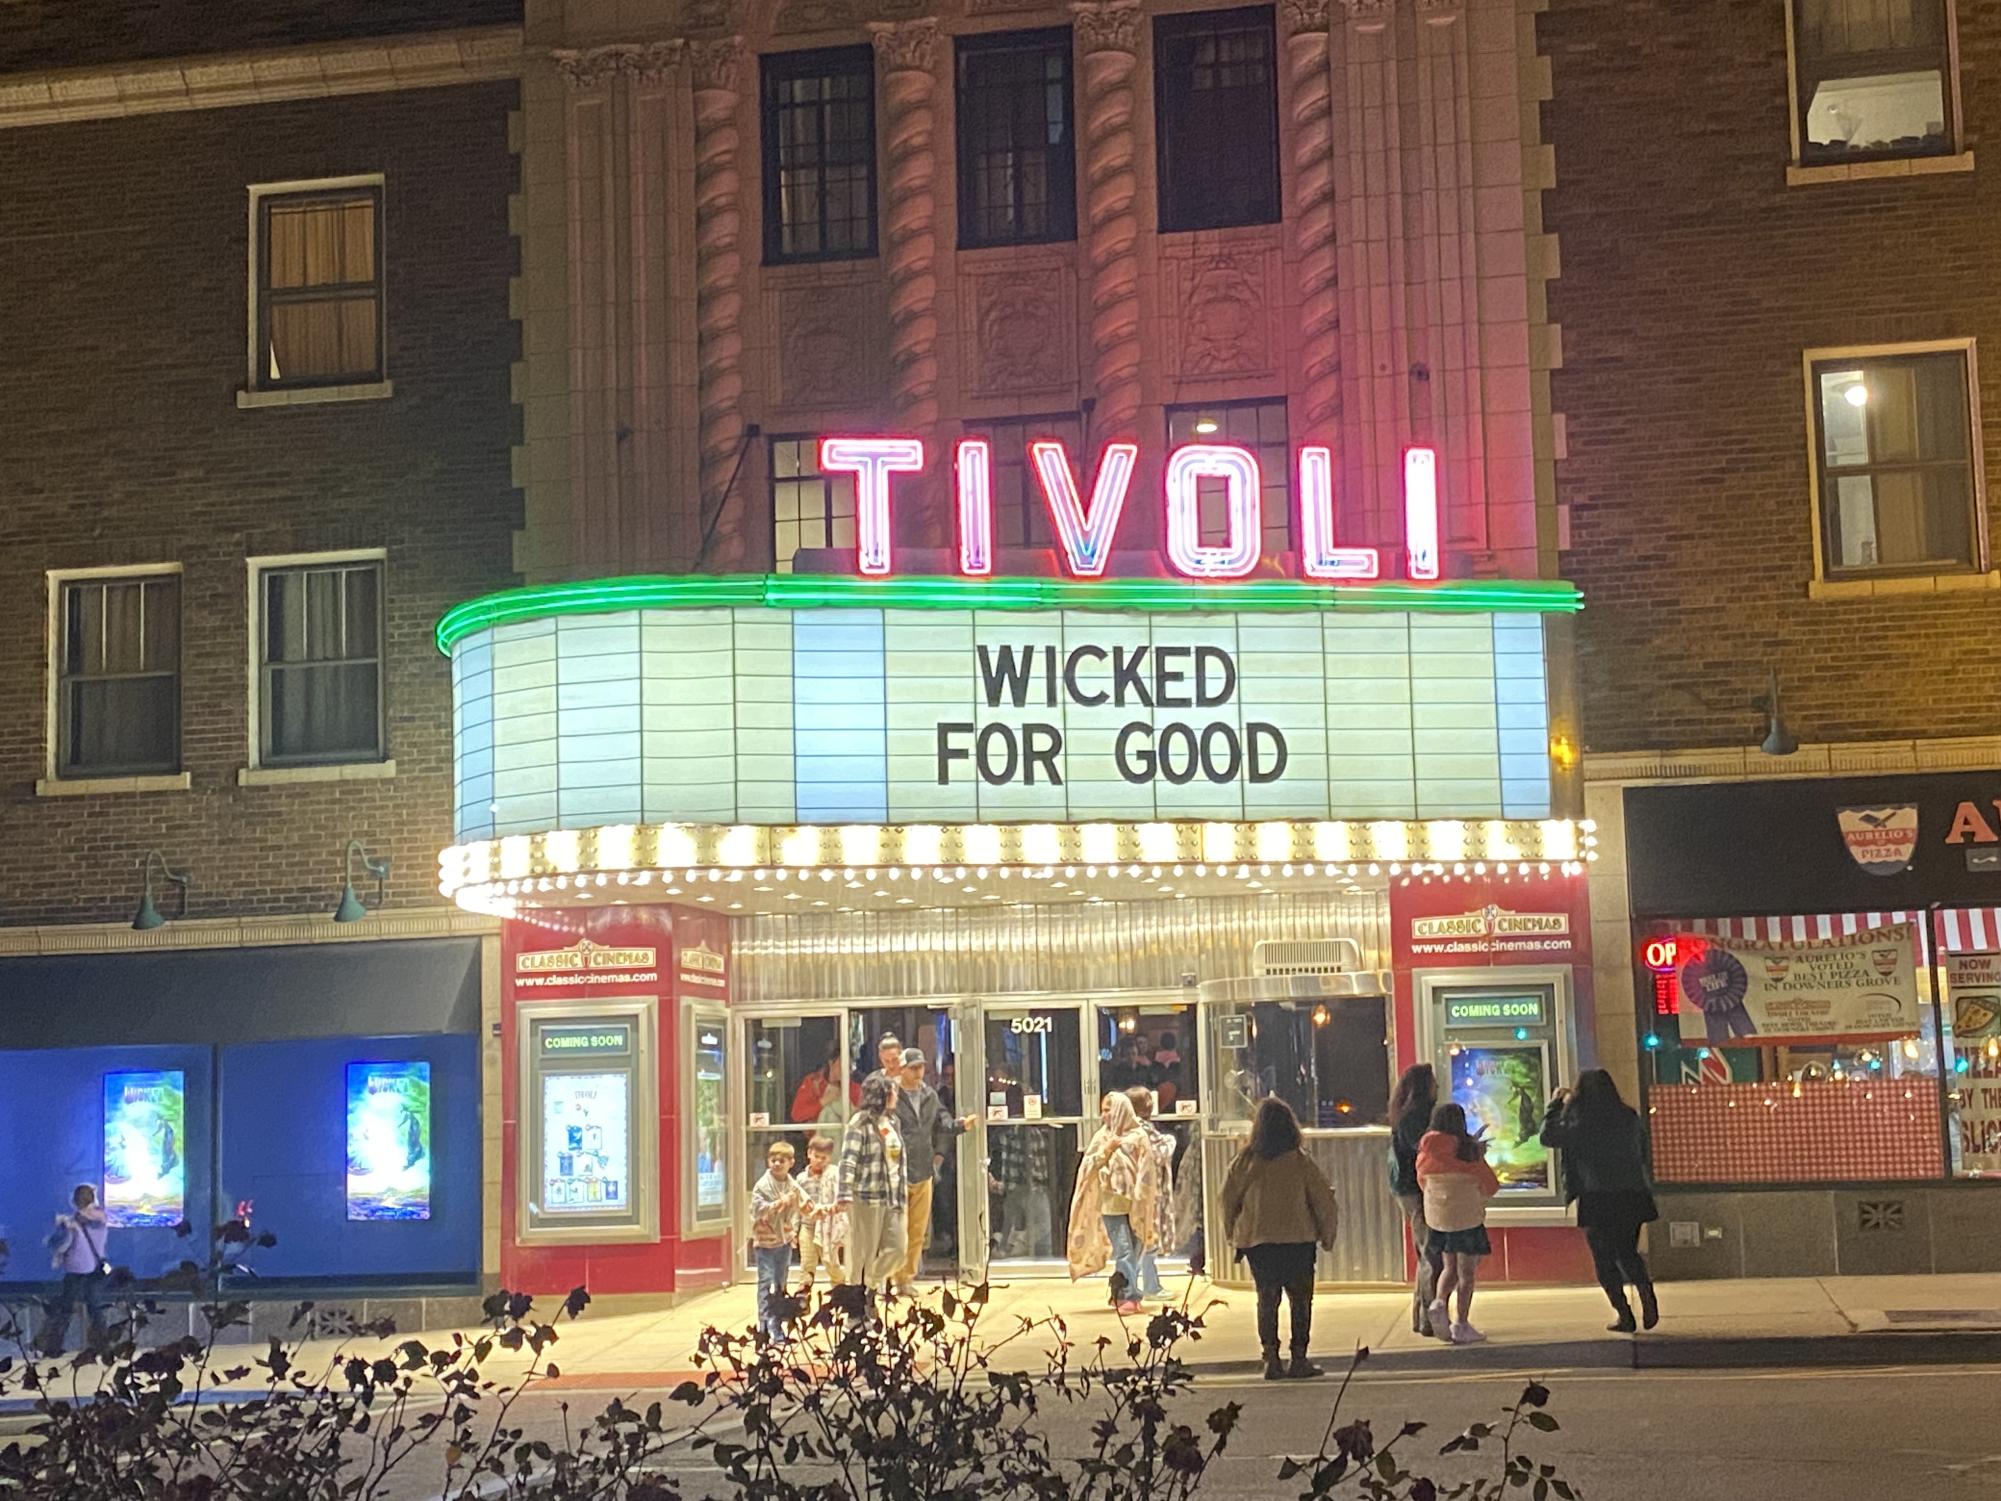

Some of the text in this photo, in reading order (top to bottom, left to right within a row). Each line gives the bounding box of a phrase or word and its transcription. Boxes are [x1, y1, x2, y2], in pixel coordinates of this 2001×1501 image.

[820, 437, 1440, 579] TIVOLI
[976, 644, 1236, 708] WICKED
[937, 720, 1288, 786] FOR GOOD
[1944, 799, 2001, 844] A
[1861, 847, 1903, 859] PIZZA
[1417, 917, 1562, 935] CLASSIC CINEMAS
[521, 951, 650, 969] CLASSIC CINEMAS
[1646, 943, 1676, 967] OP
[1809, 962, 1854, 971] VOTED
[1959, 959, 1991, 970] NOW
[1764, 976, 1901, 991] IN DOWNERS GROVE
[1793, 969, 1870, 981] BEST PIZZA
[1451, 1003, 1538, 1017] COMING SOON
[1011, 1016, 1052, 1033] 5021
[545, 1035, 623, 1048] COMING SOON
